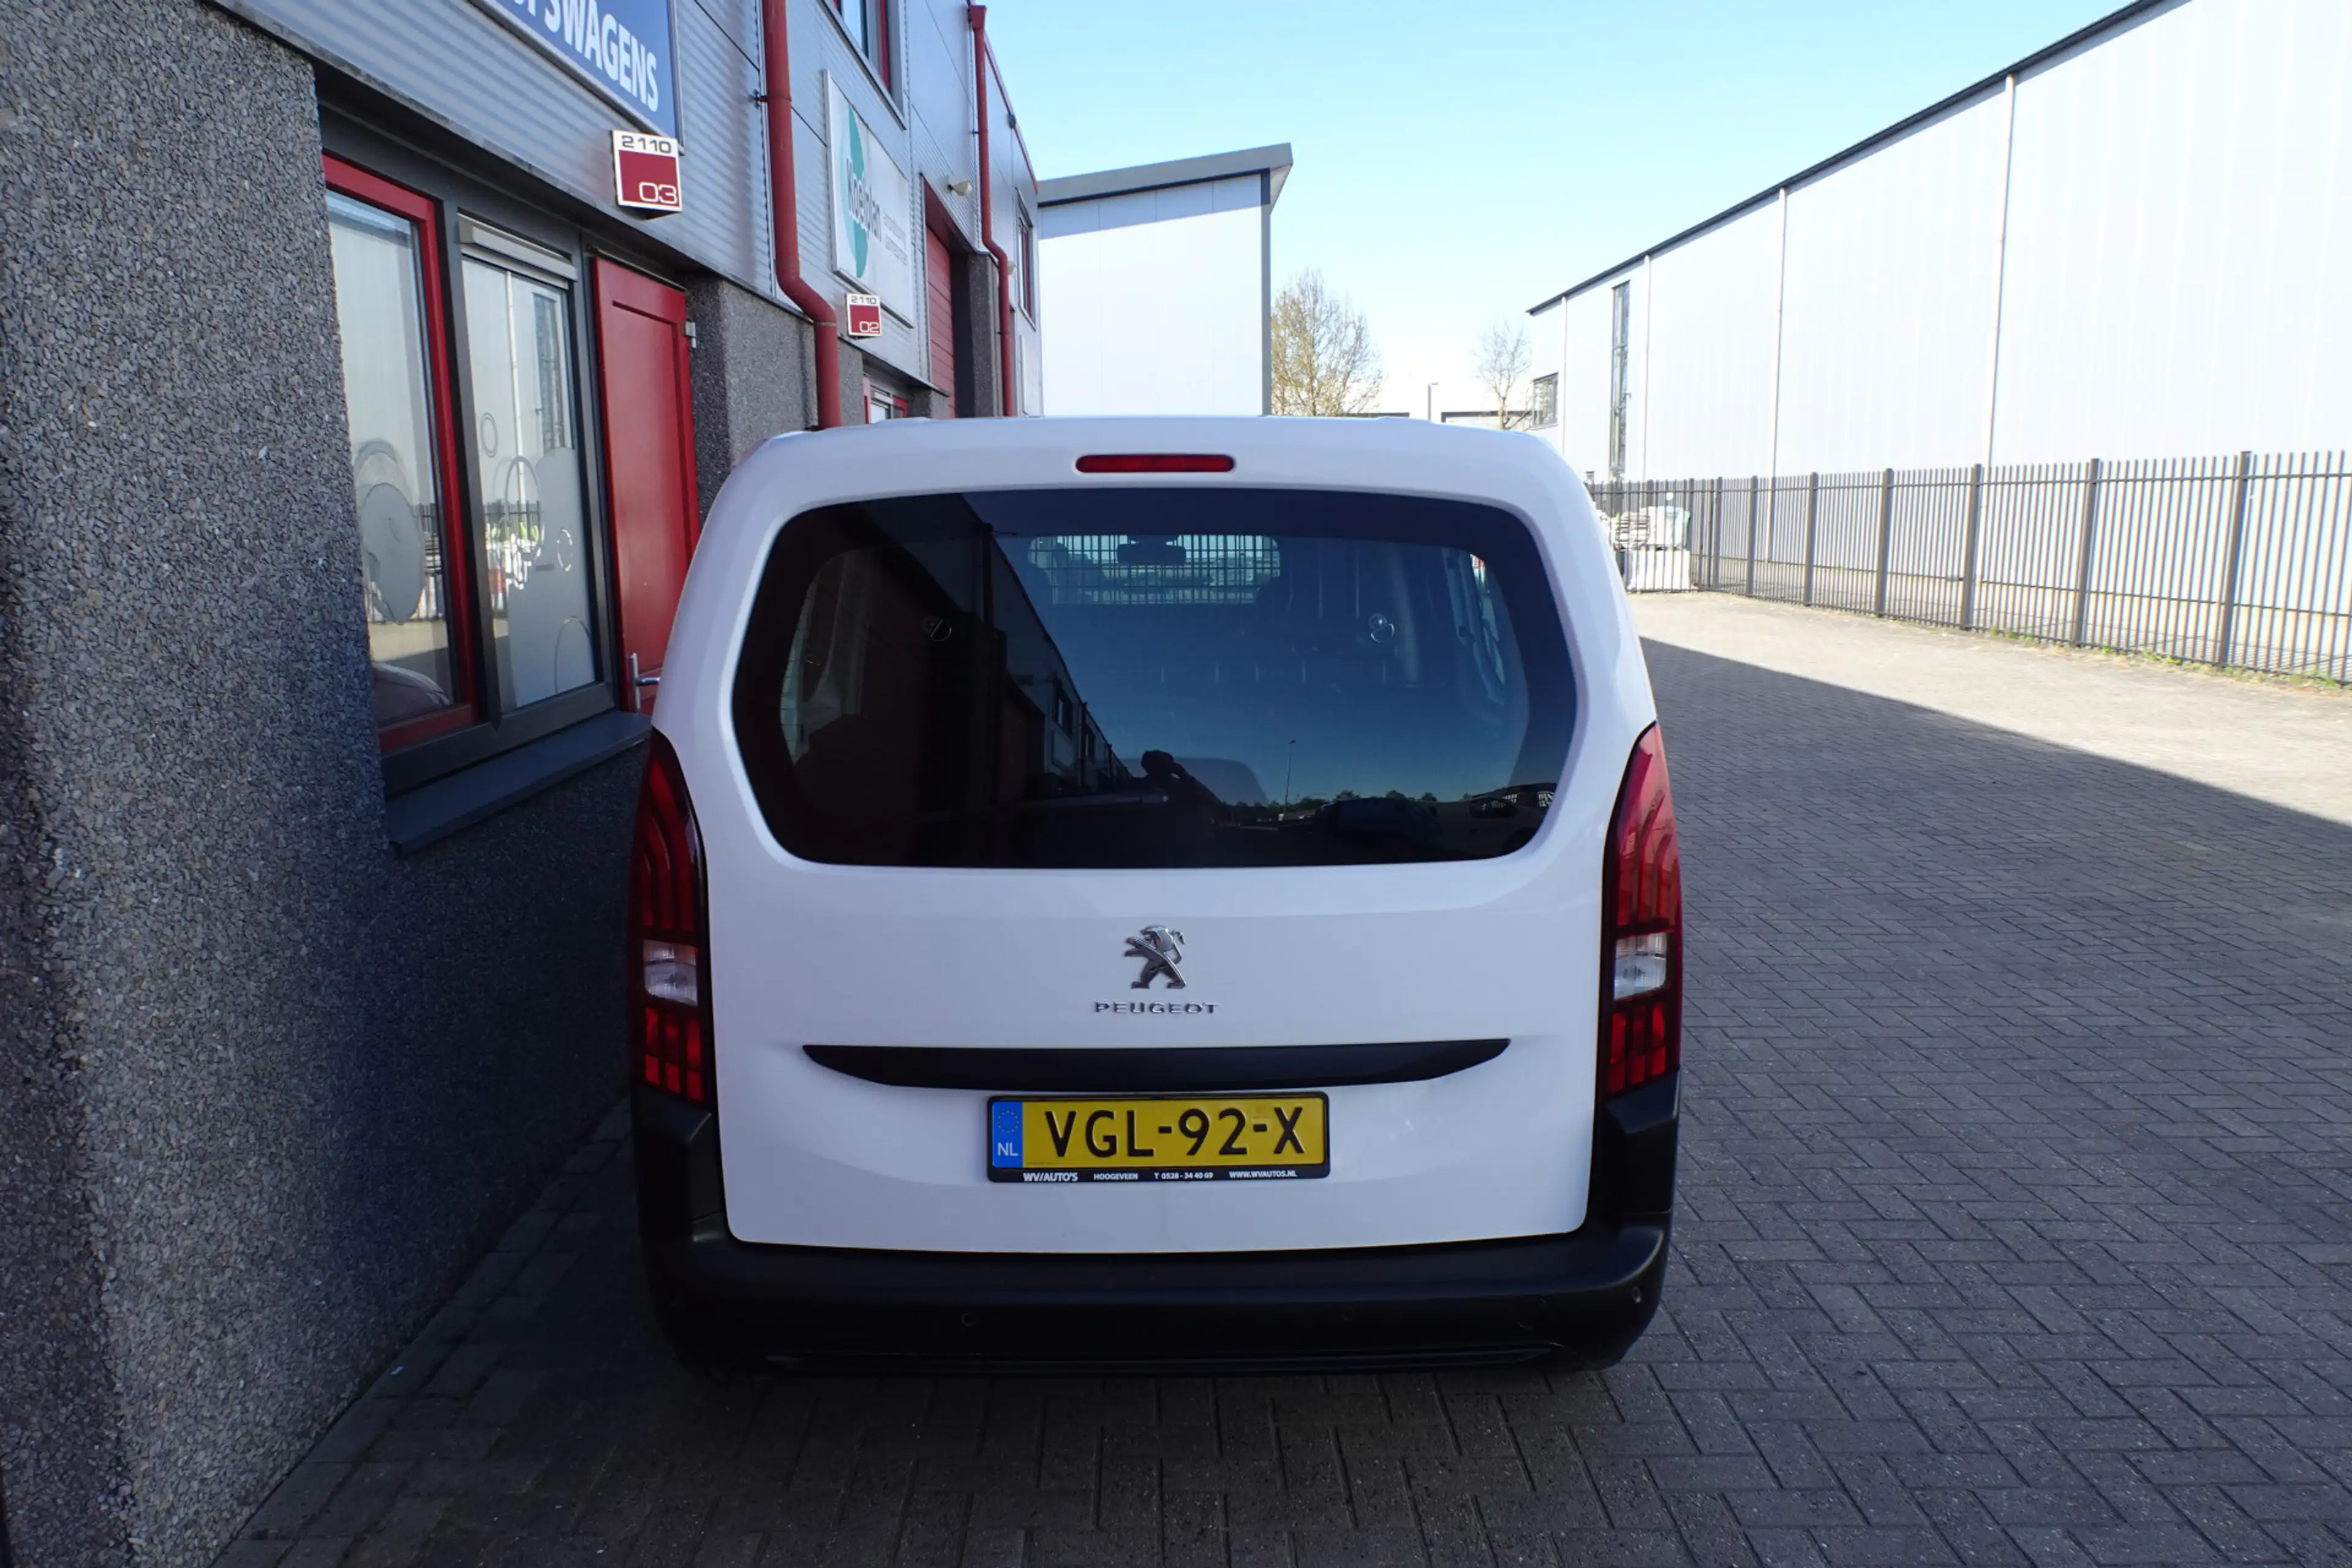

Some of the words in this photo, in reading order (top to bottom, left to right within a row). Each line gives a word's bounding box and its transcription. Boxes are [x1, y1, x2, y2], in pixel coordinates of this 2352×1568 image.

[513, 0, 658, 112] WAGENS
[621, 135, 671, 154] 2110
[639, 182, 677, 205] 03
[850, 295, 877, 305] 2110
[859, 321, 880, 333] 02
[1093, 1001, 1221, 1014] PEUGEOT
[1044, 1106, 1306, 1158] VGL-92-X
[997, 1142, 1019, 1156] NL
[1023, 1172, 1079, 1182] WV/AUTO'S
